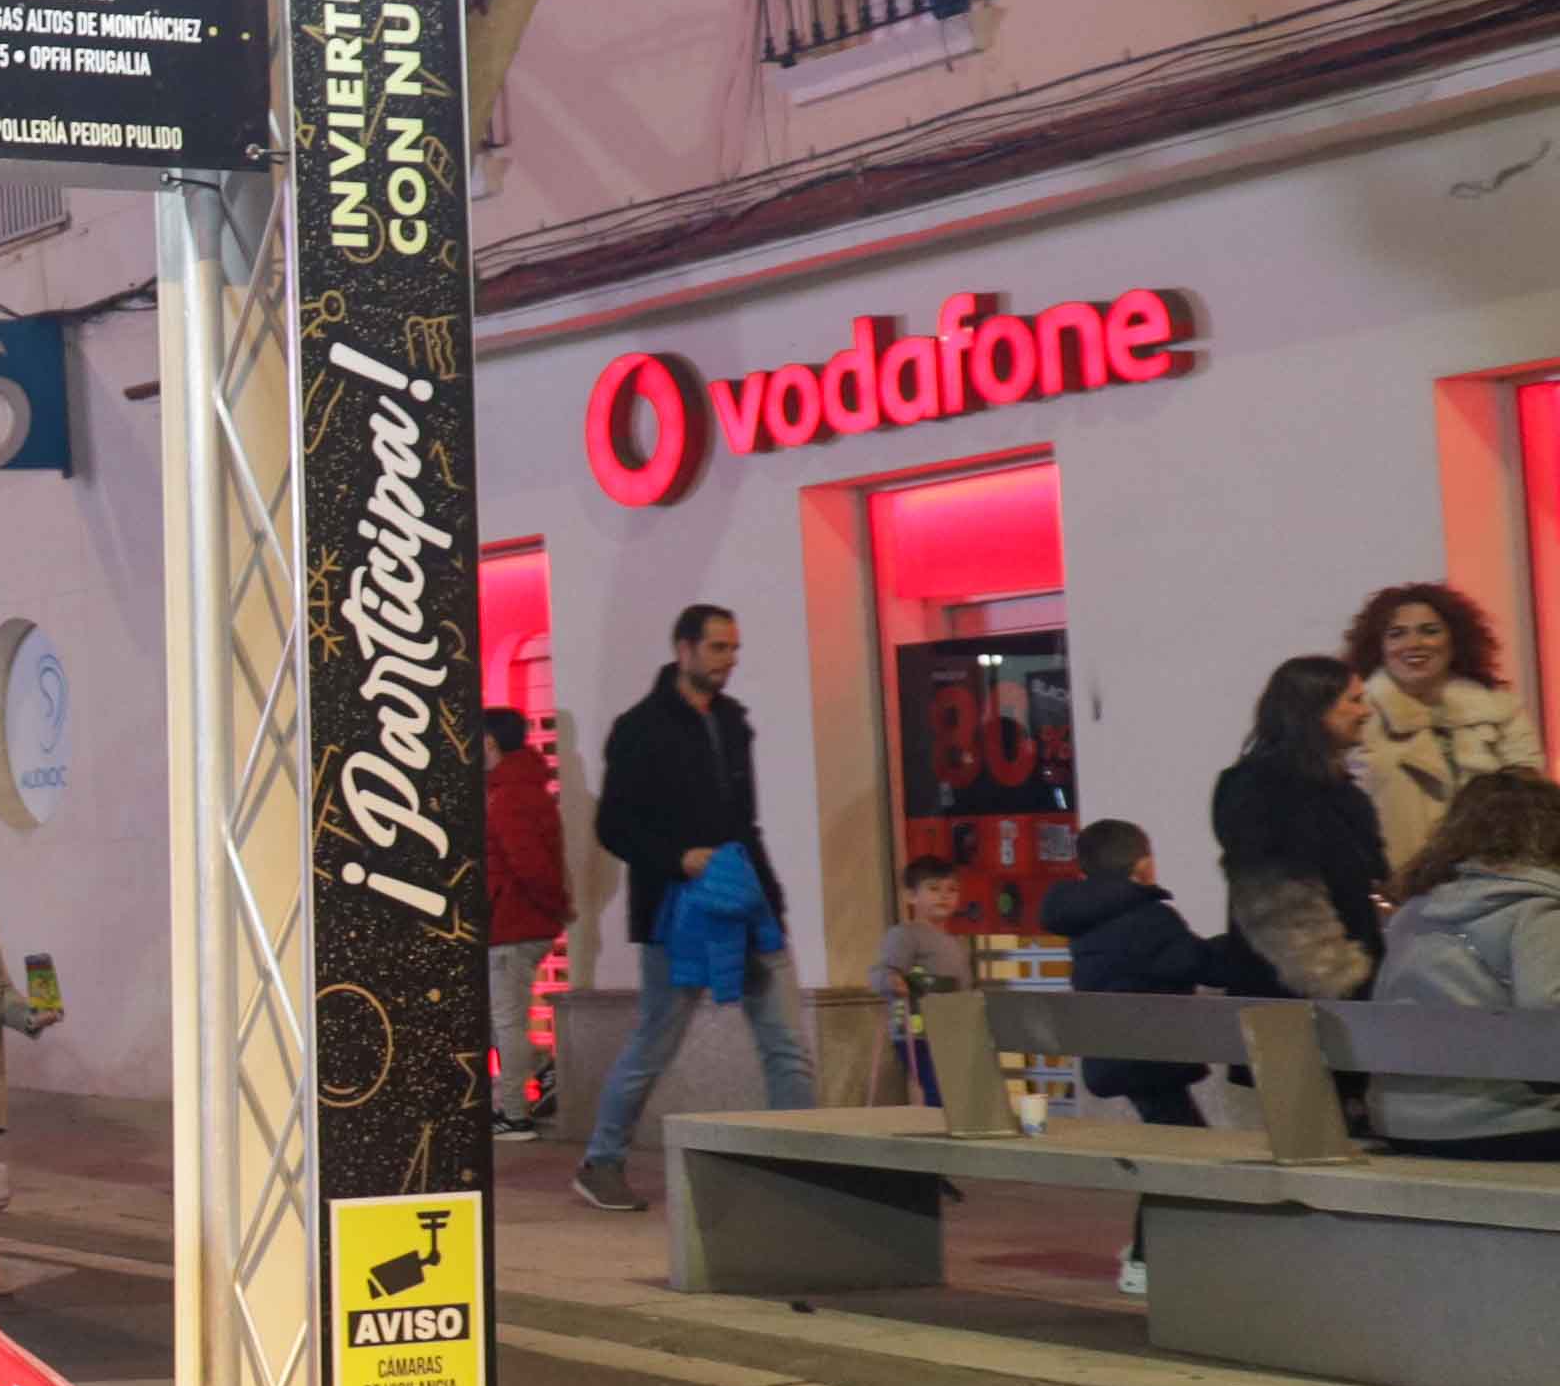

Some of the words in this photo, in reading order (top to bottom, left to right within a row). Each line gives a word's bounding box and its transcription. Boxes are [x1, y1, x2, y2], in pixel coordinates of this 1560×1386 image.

[30, 46, 71, 71] OPFH
[75, 48, 151, 75] FRUGALIA
[70, 122, 122, 147] PEDRO
[126, 125, 182, 150] PULIDO
[386, 119, 428, 254] CON
[708, 287, 1182, 455] vodafone
[354, 1307, 464, 1345] AVISO
[378, 1355, 443, 1379] CÁMARAS
